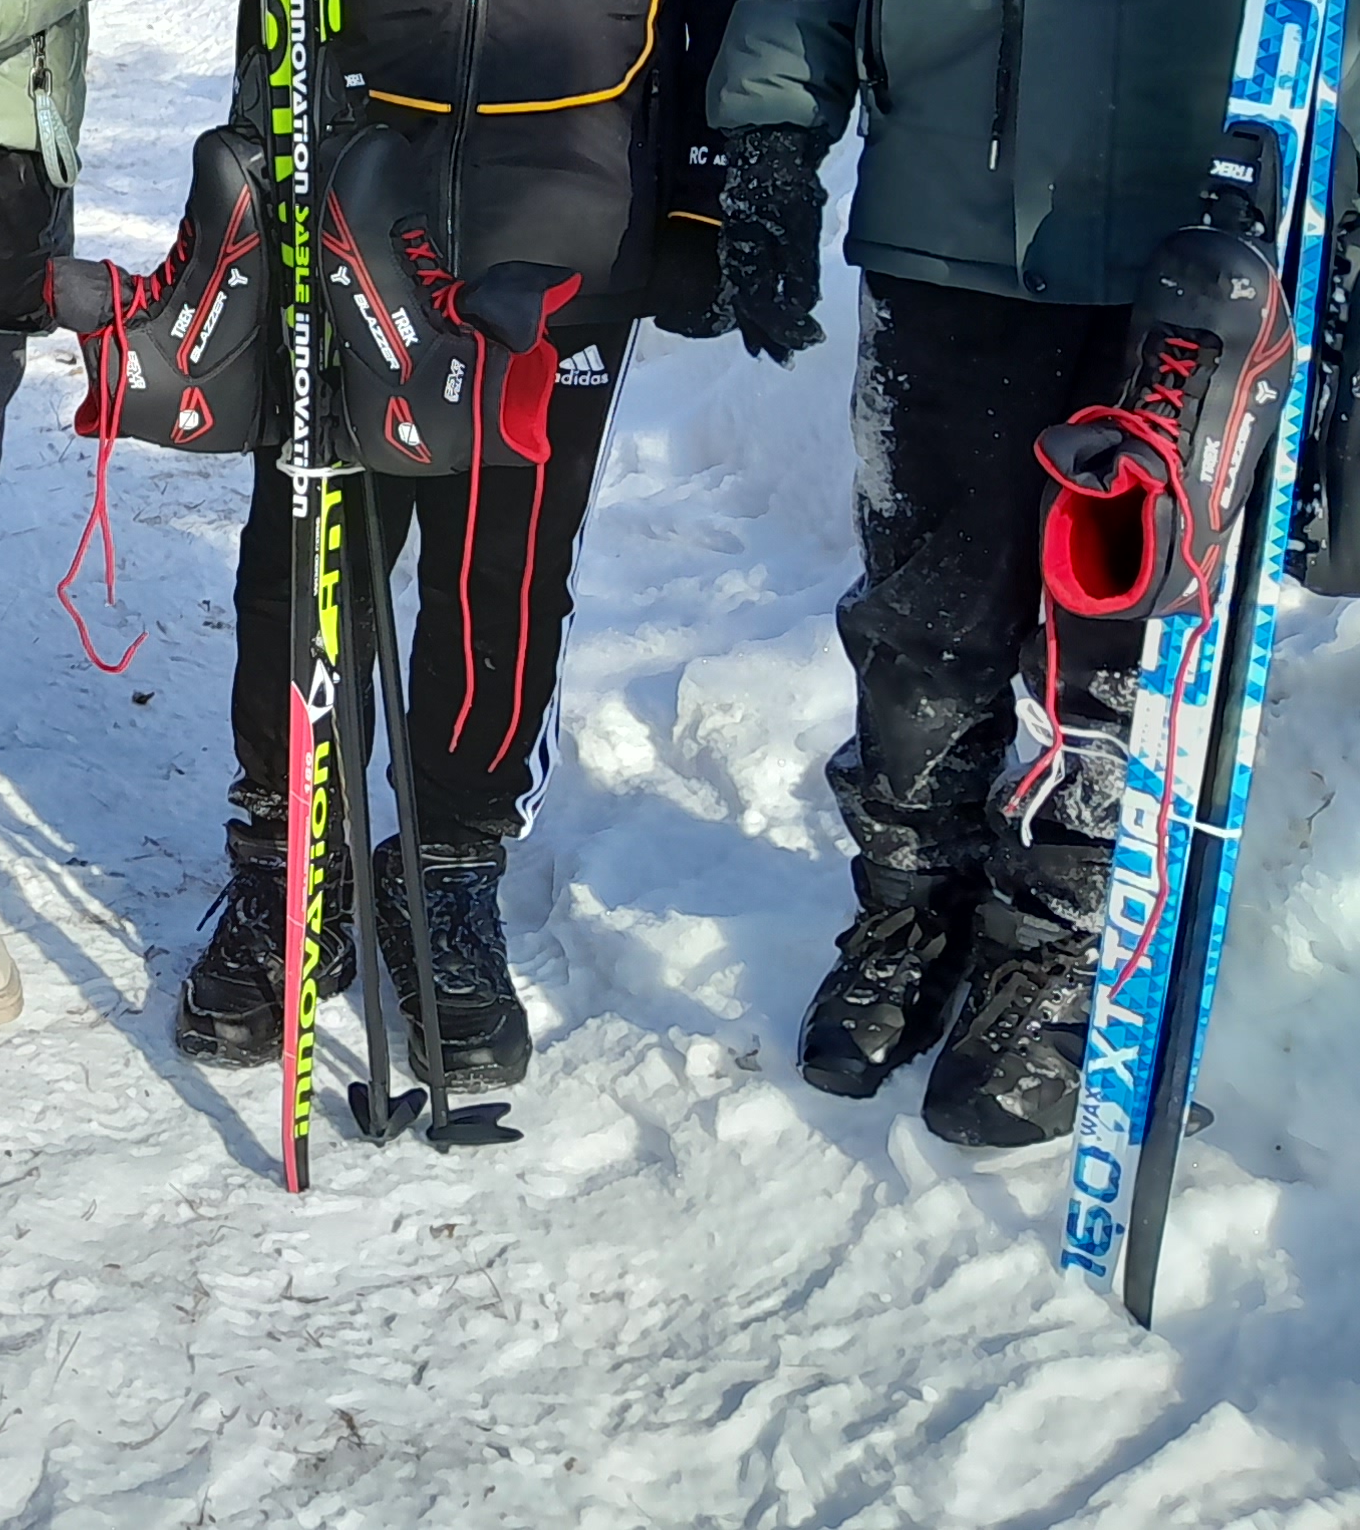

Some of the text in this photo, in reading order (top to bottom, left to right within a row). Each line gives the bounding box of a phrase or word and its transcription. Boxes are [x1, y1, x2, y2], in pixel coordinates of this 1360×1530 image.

[689, 146, 709, 165] RC
[1210, 159, 1255, 183] TREK
[294, 203, 310, 305] SABLE
[170, 303, 196, 338] TREK
[190, 290, 227, 363] BLAZZER
[353, 293, 400, 369] BLAZZER
[391, 306, 419, 347] TREK
[1200, 436, 1220, 482] TREK
[1220, 411, 1255, 509] BLAZZER
[1061, 787, 1168, 1278] 160 WAX XT TOUR
